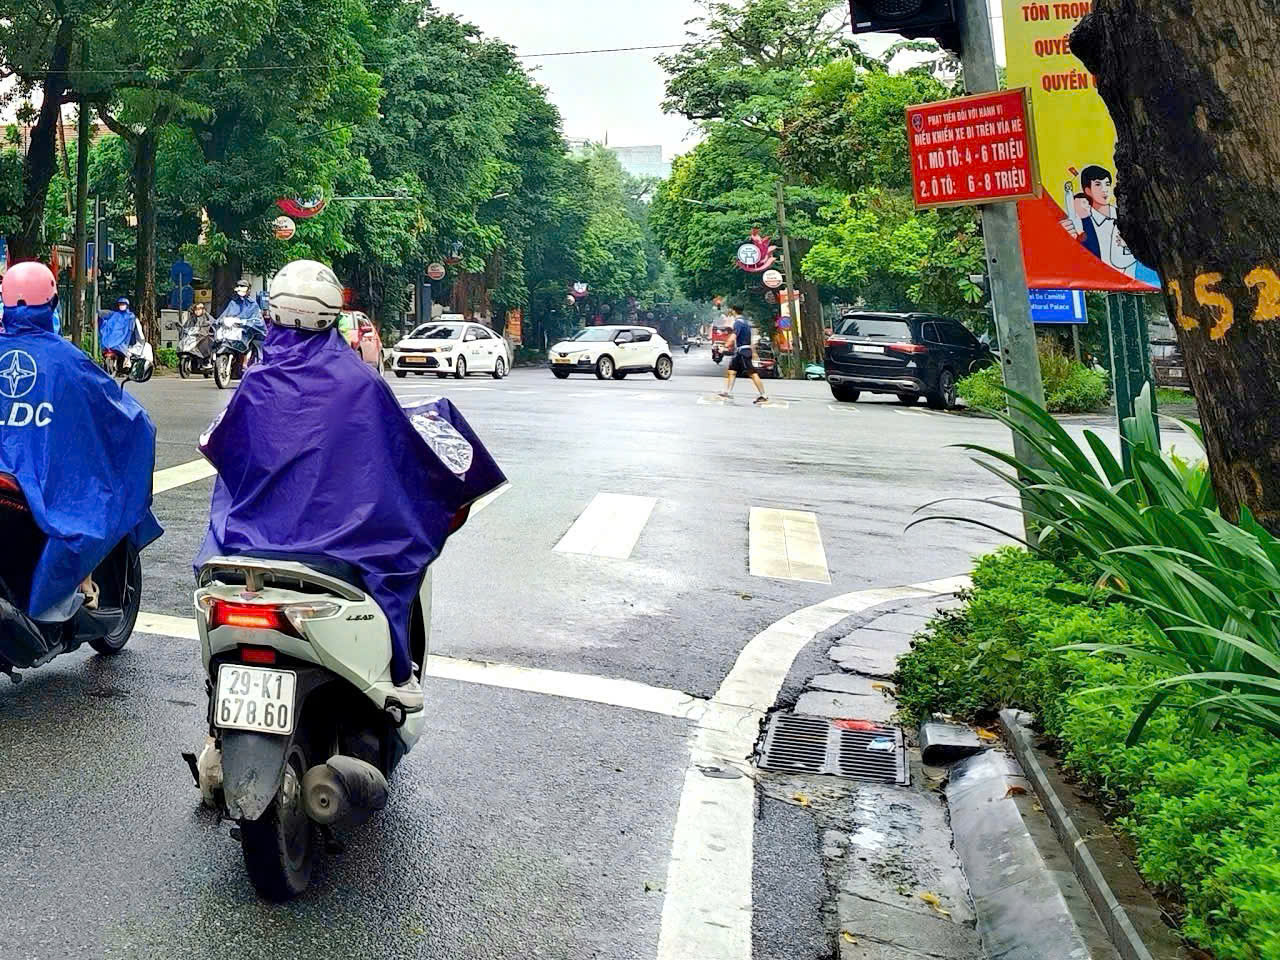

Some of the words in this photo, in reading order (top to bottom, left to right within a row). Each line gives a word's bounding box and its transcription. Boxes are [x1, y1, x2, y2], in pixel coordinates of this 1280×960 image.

[1022, 2, 1050, 22] TÔN
[1053, 2, 1093, 22] TRỌN
[1042, 68, 1088, 92] QUYỀN
[955, 127, 965, 140] XE
[966, 126, 975, 138] ĐI
[976, 121, 995, 137] TRÊN
[1011, 116, 1022, 132] HÈ
[917, 154, 927, 170] 1.
[928, 148, 945, 169] MÔ
[946, 145, 963, 167] TÔ:
[965, 147, 972, 164] 4
[981, 145, 988, 162] 6
[991, 137, 1024, 163] TRIỆU
[940, 174, 957, 195] TÔ:
[967, 175, 975, 193] 6
[984, 173, 991, 191] 8
[994, 166, 1026, 192] TRIỆU
[229, 670, 282, 700] 29-K1
[221, 697, 288, 728] 678.60
